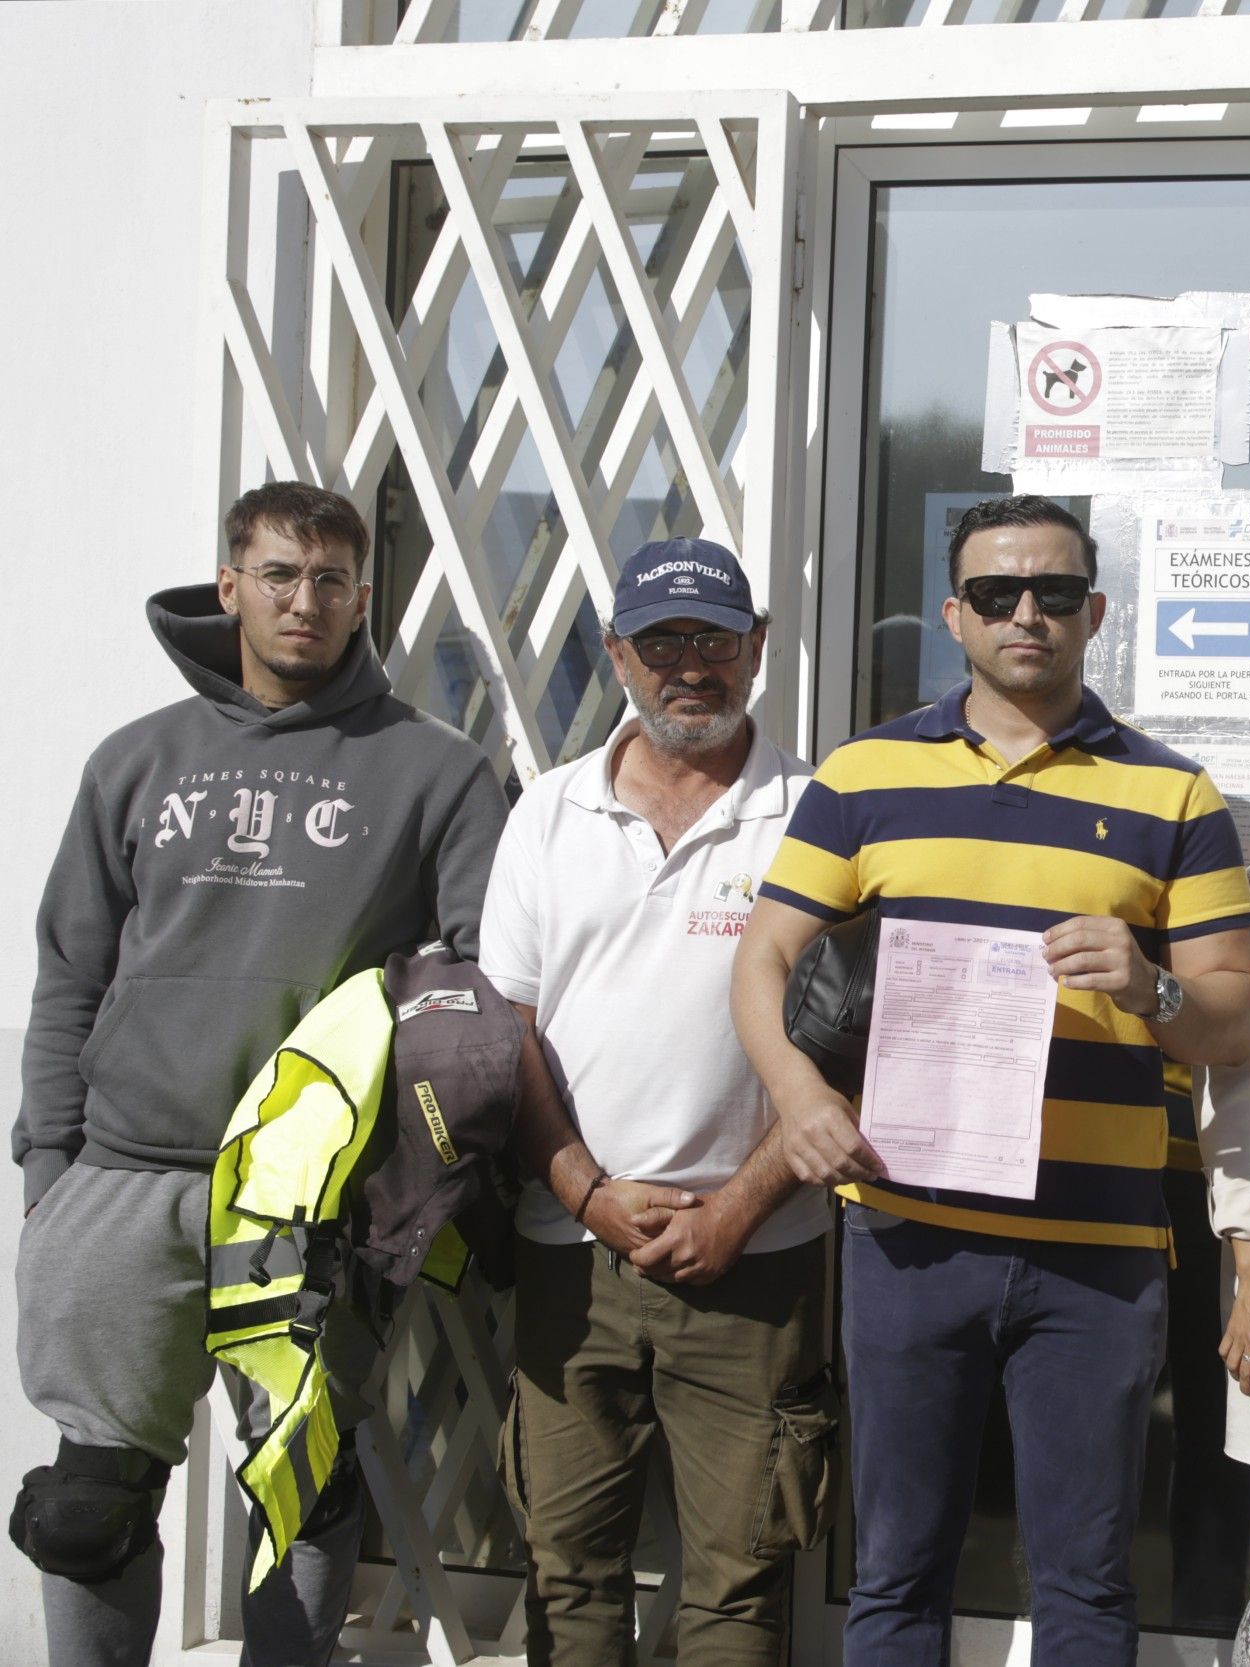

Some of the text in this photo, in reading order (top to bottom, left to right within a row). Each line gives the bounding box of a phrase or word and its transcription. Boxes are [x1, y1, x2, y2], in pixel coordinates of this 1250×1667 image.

[1034, 429, 1092, 439] PROHIBIDO
[1035, 444, 1089, 453] ANIMALES
[636, 560, 732, 587] JACKSONVILLE
[1170, 569, 1250, 588] TEÓRICOS
[1158, 669, 1196, 678] ENTRADA
[1198, 670, 1215, 678] POR
[1217, 670, 1228, 678] LA
[1189, 681, 1231, 689] SIGUIENTE
[1161, 691, 1202, 700] (PASANDO
[1204, 692, 1213, 700] EL
[1216, 692, 1247, 700] PORTAL
[178, 768, 347, 791] TIMES SQUARE
[181, 873, 306, 889] Neighborhood Midtown Manhattan
[991, 964, 1027, 976] ENTRADA
[417, 1084, 459, 1165] PRO-BIKER
